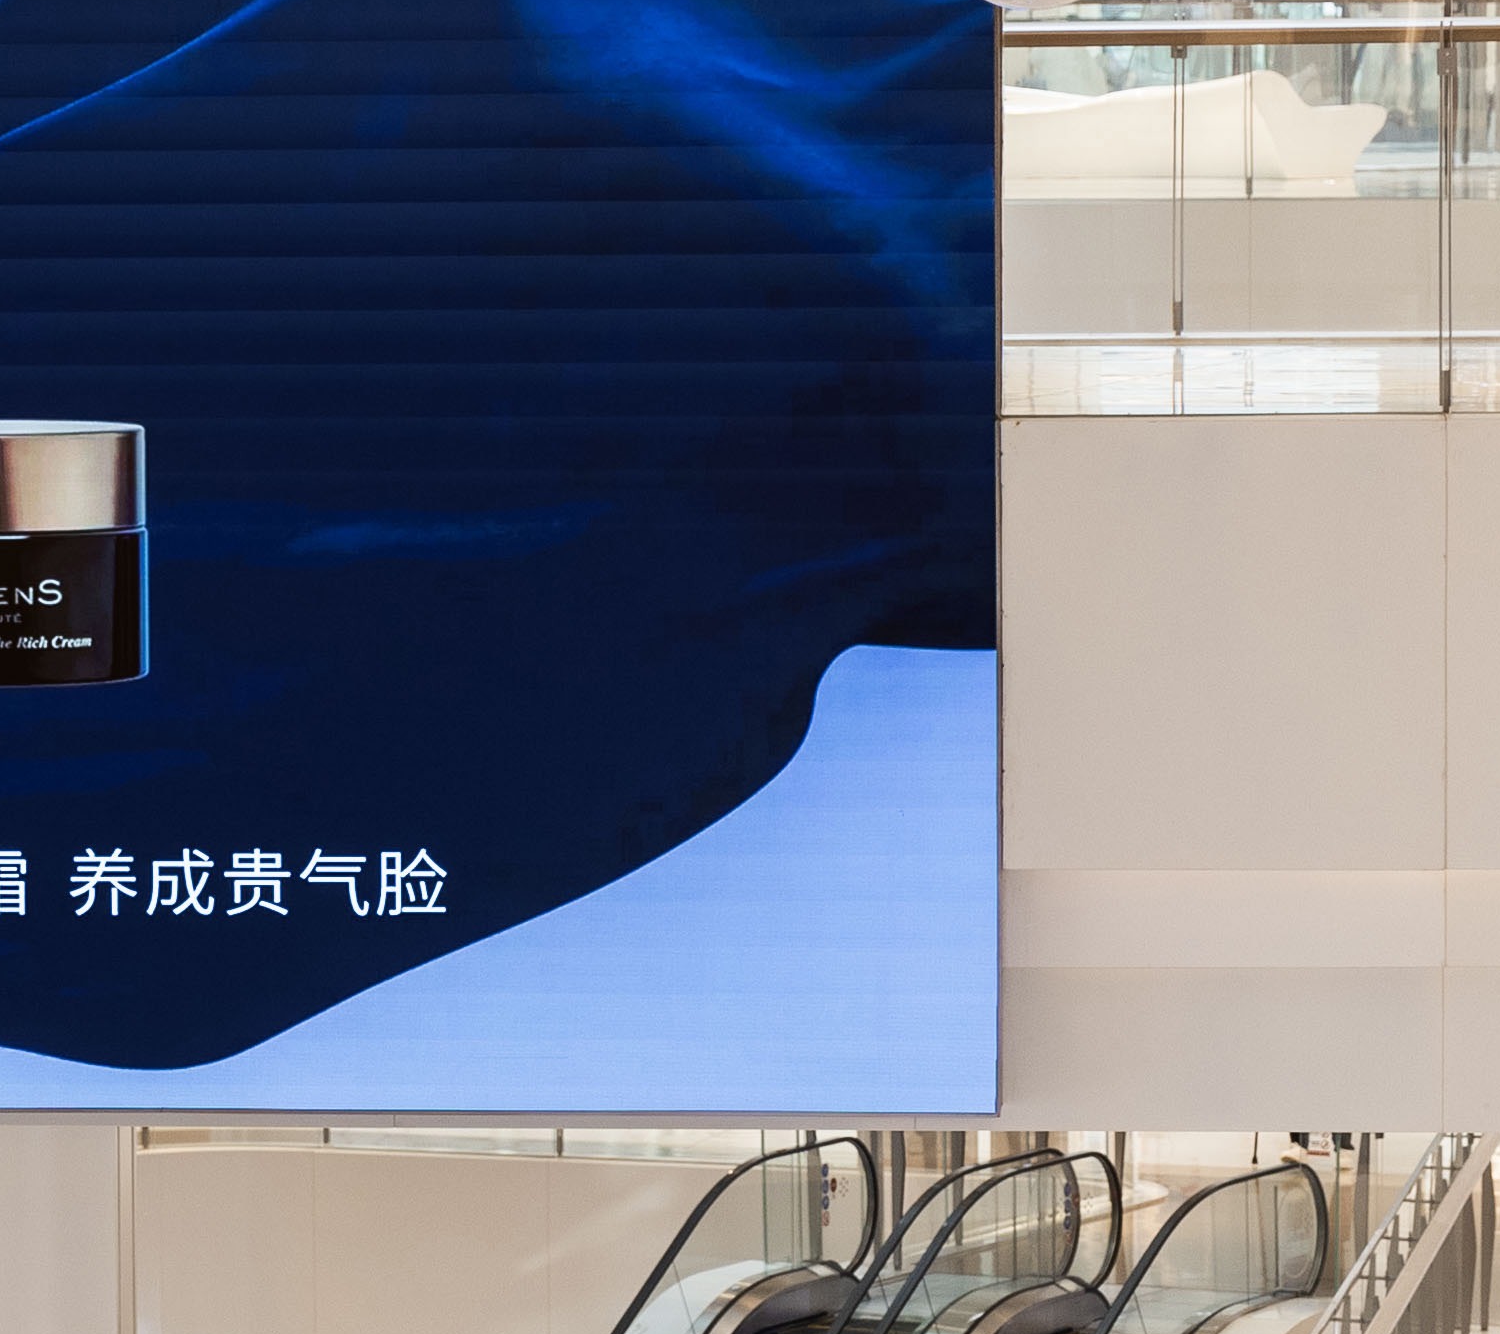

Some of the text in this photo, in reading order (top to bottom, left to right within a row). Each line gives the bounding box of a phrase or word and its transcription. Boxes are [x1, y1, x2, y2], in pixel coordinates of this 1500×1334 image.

[16, 635, 49, 650] Rich
[50, 634, 93, 650] Cream
[69, 847, 448, 917] 养成贵气脸
